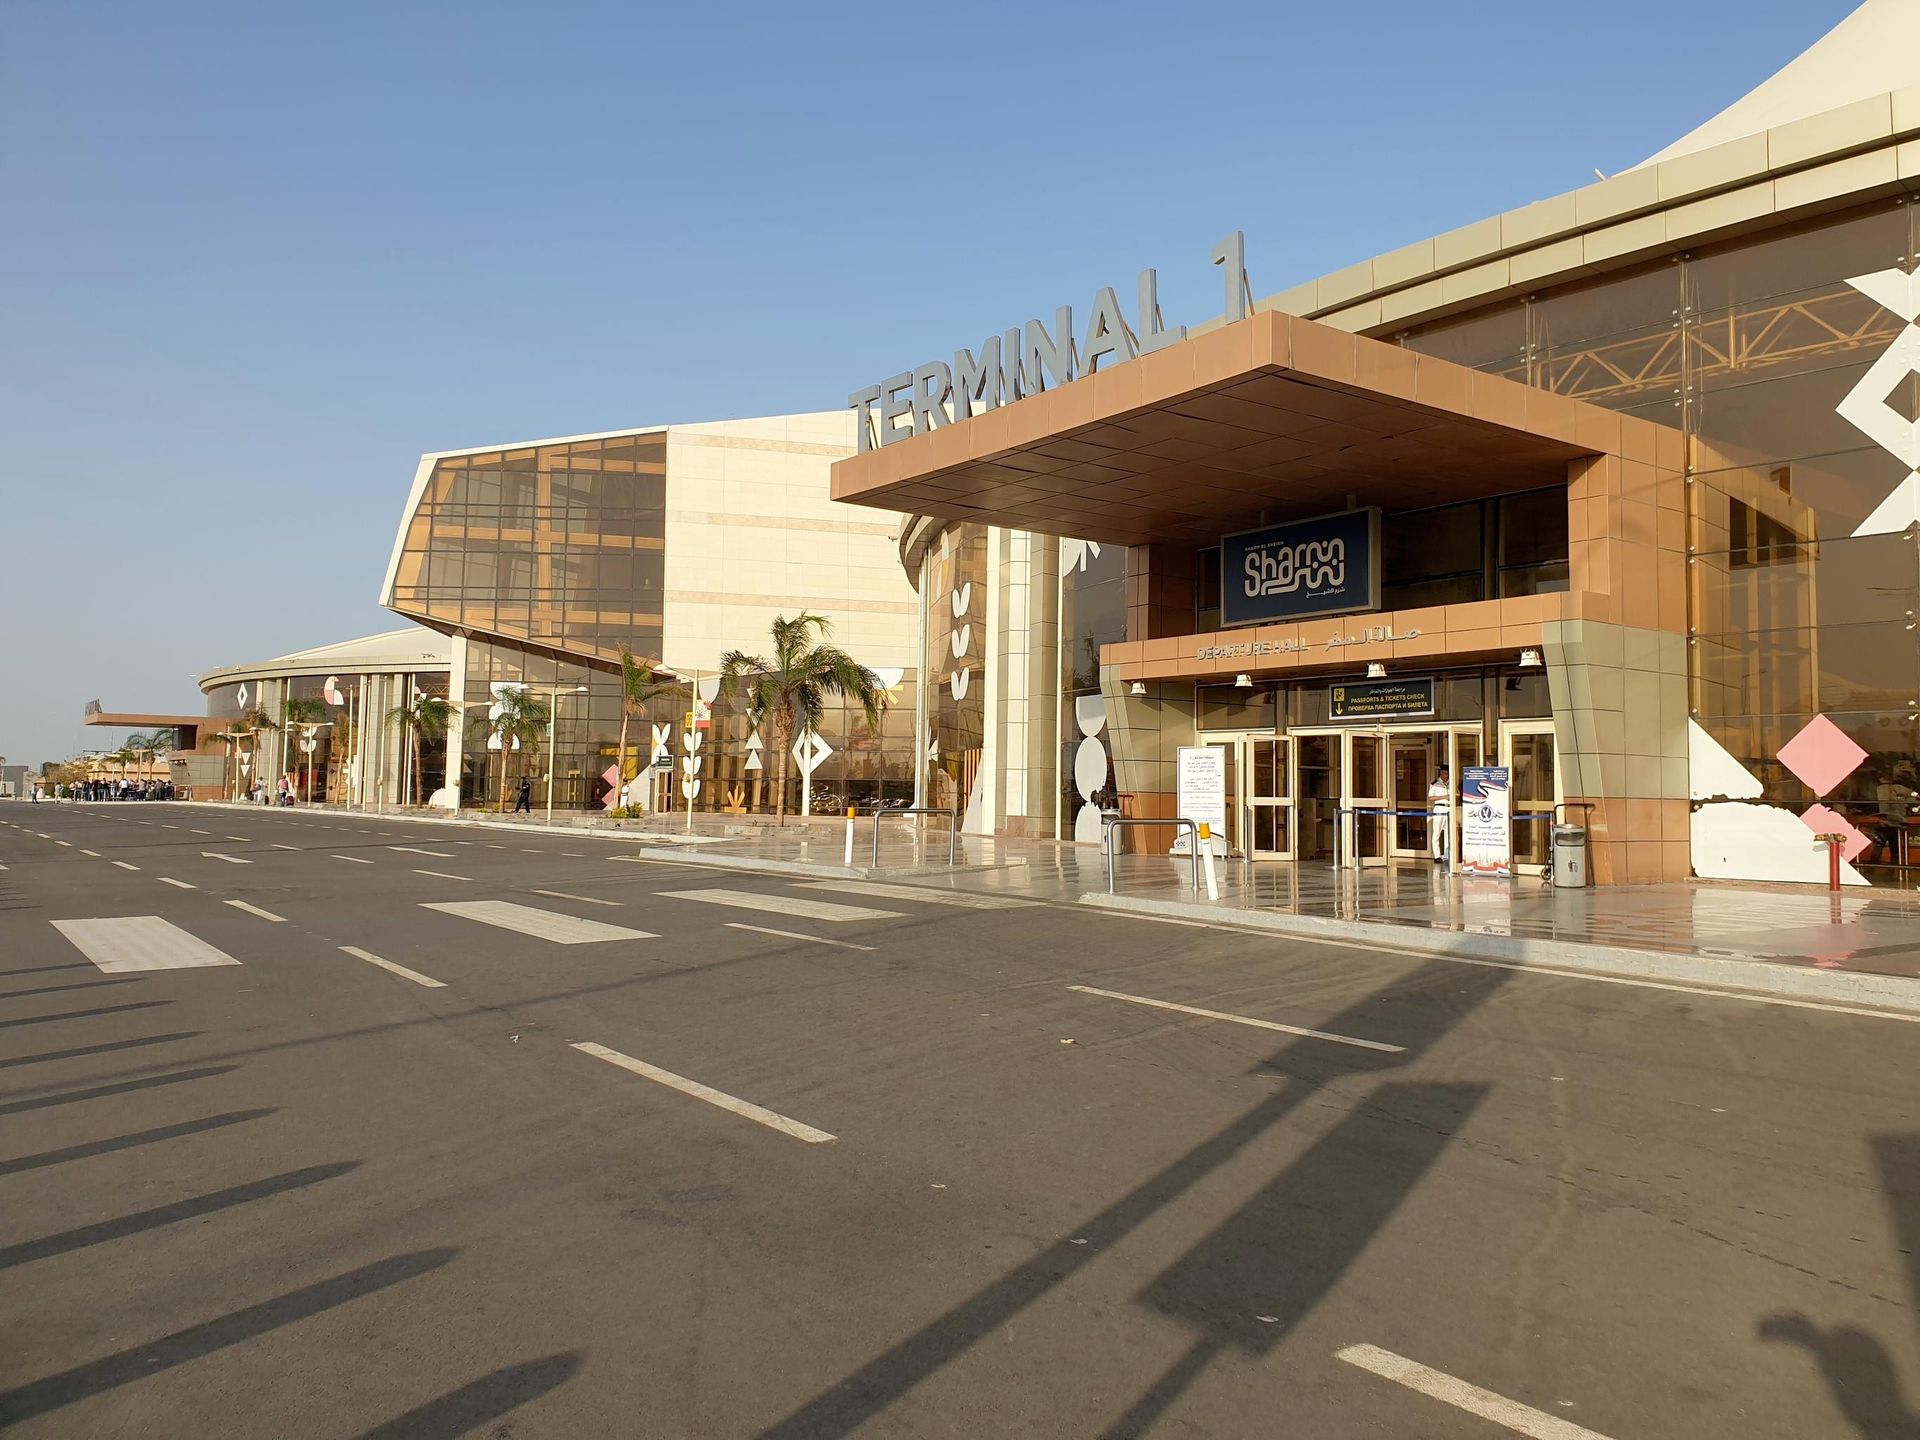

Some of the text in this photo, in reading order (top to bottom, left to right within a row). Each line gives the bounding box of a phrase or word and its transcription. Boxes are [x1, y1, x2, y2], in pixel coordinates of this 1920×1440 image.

[848, 230, 1245, 454] TERMINAL 1
[1196, 636, 1310, 661] DEPARTURE HALL
[1350, 696, 1379, 704] PASSPORTS
[1374, 703, 1402, 711] ПАСПОРТА
